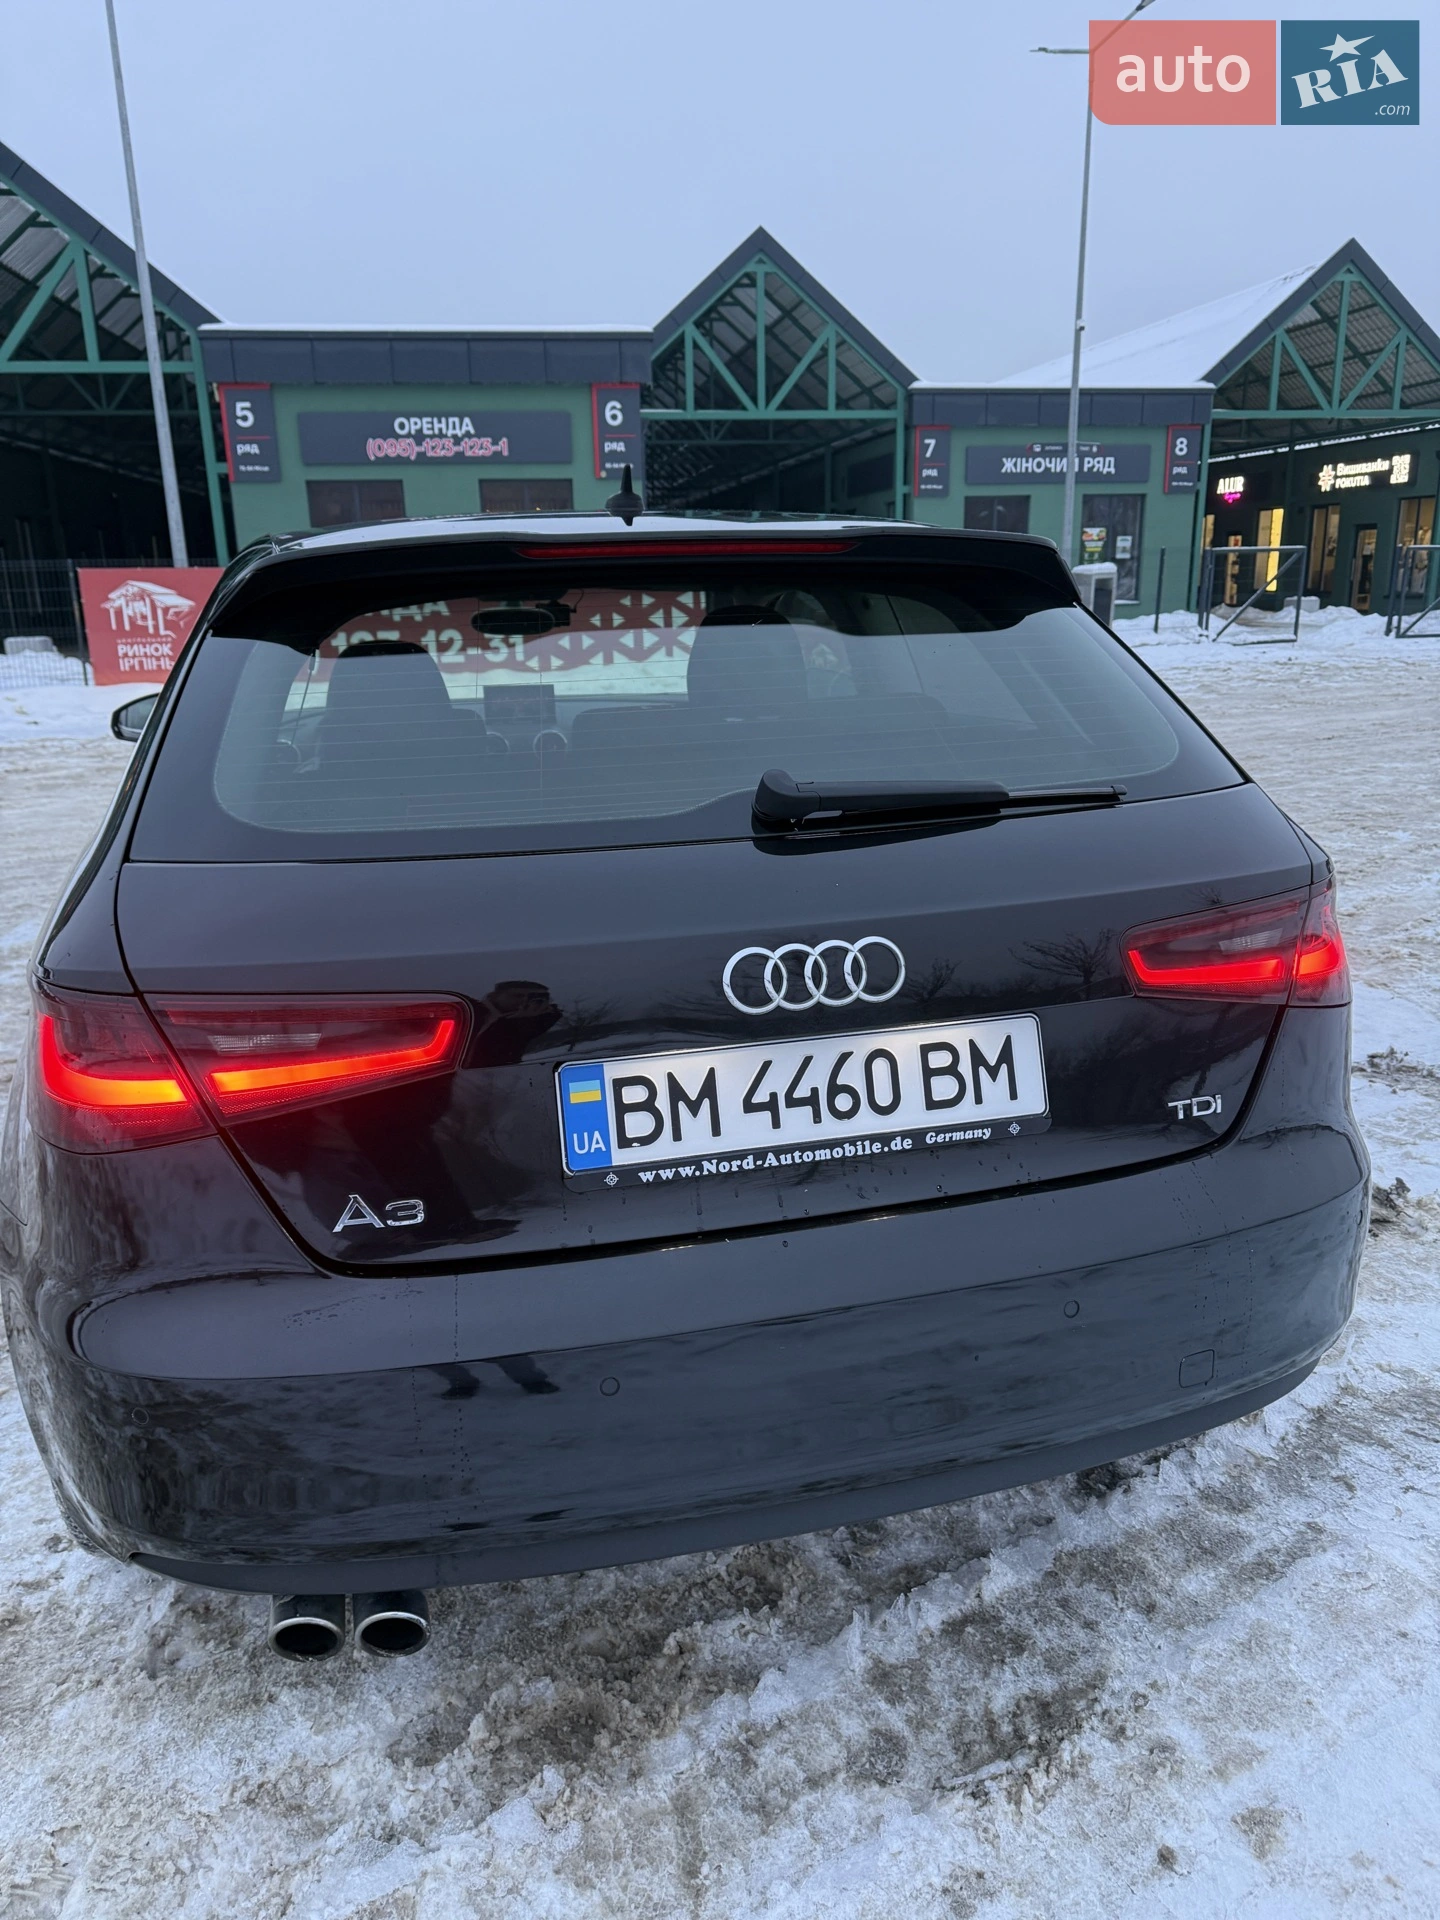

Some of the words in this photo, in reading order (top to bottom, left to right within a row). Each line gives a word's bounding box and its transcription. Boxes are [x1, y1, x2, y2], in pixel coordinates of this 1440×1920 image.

[235, 401, 254, 428] 5
[604, 400, 623, 427] 6
[393, 416, 475, 437] ОРЕНДА
[236, 443, 260, 456] ряд
[604, 441, 626, 453] ряд
[923, 438, 936, 458] 7
[1174, 436, 1188, 456] 8
[1083, 456, 1116, 474] РЯД
[117, 643, 173, 657] РИНОК
[119, 657, 175, 672] ІРПІНЬ
[612, 1066, 722, 1150] BM
[742, 1047, 901, 1130] 4460
[919, 1034, 1018, 1111] BM
[1167, 1094, 1222, 1120] TDI
[573, 1131, 607, 1155] UA
[638, 1137, 913, 1183] www.Nord-Automobile.de
[925, 1127, 992, 1144] Germany
[332, 1194, 425, 1233] A3
